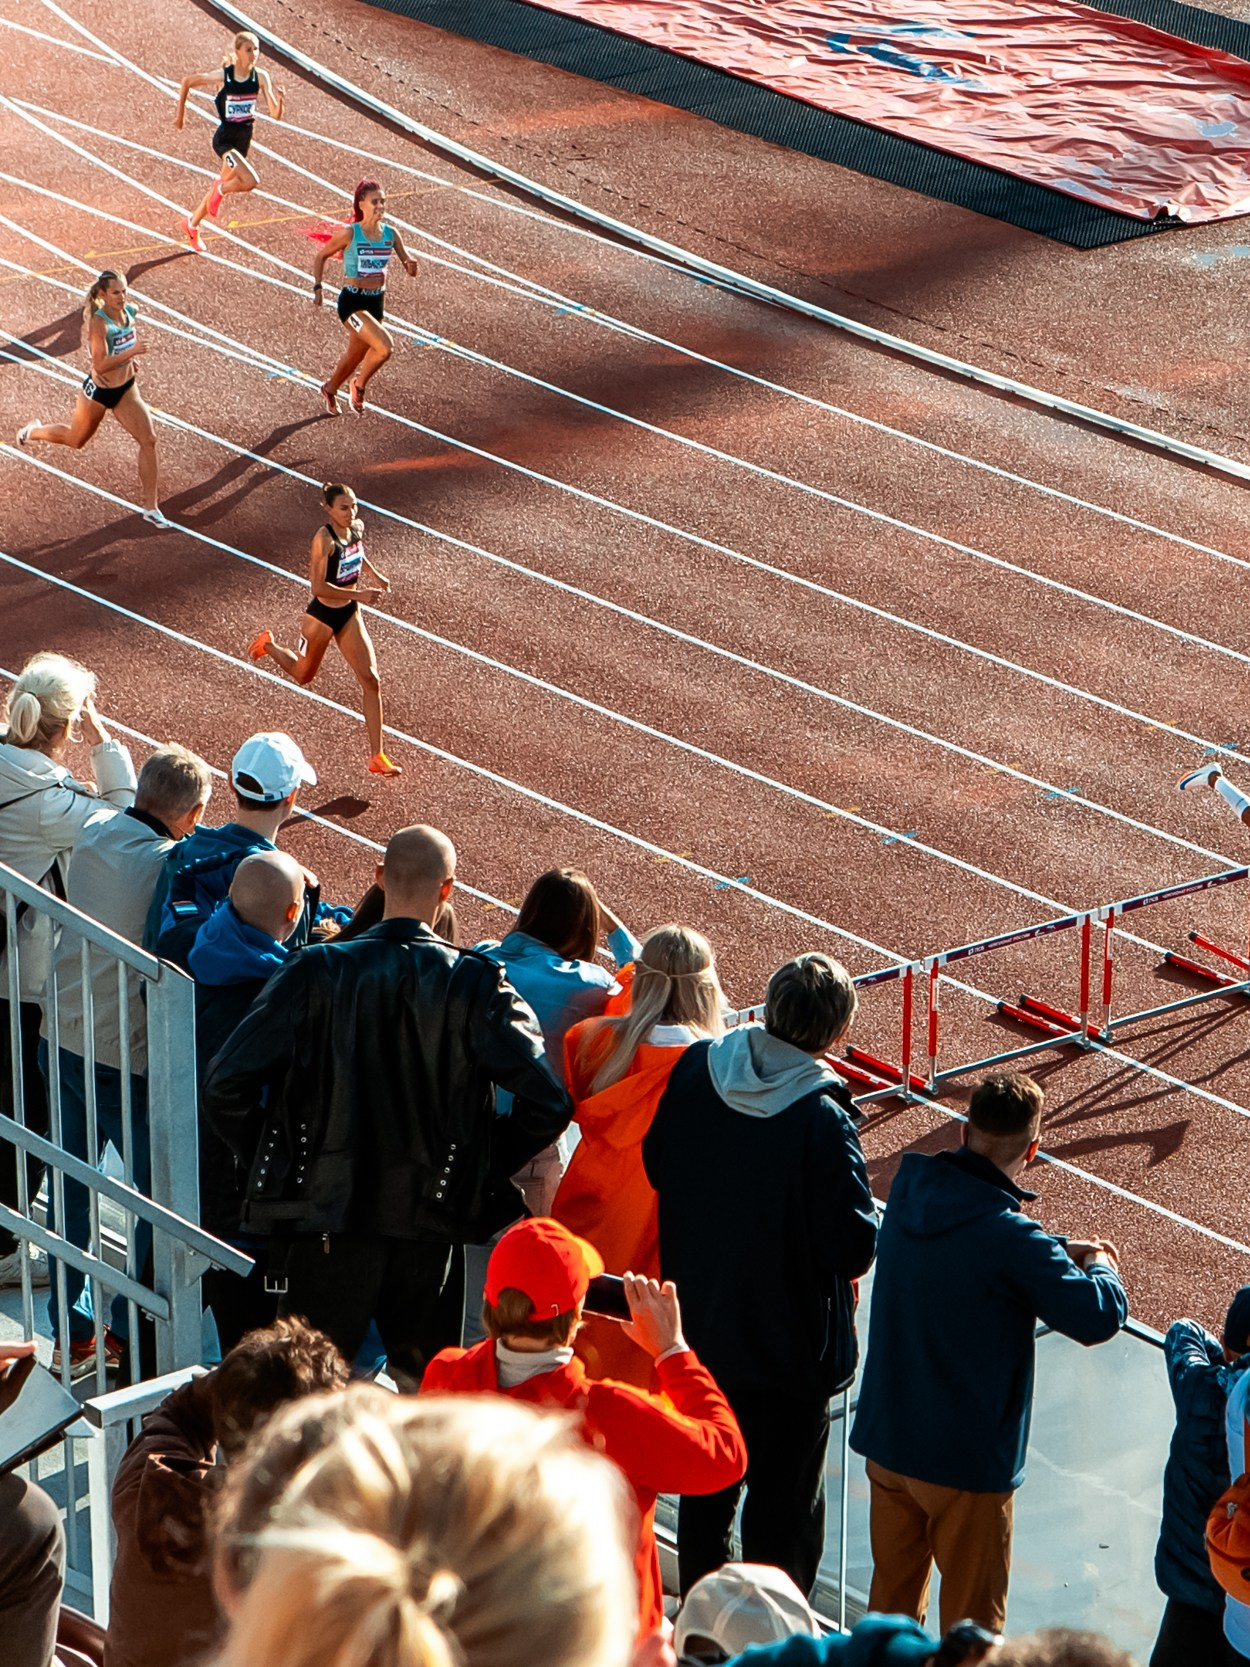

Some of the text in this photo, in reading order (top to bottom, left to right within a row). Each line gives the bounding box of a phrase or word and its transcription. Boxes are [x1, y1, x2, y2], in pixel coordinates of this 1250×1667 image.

[225, 155, 235, 168] 3
[350, 315, 360, 328] 4
[85, 382, 94, 396] 6
